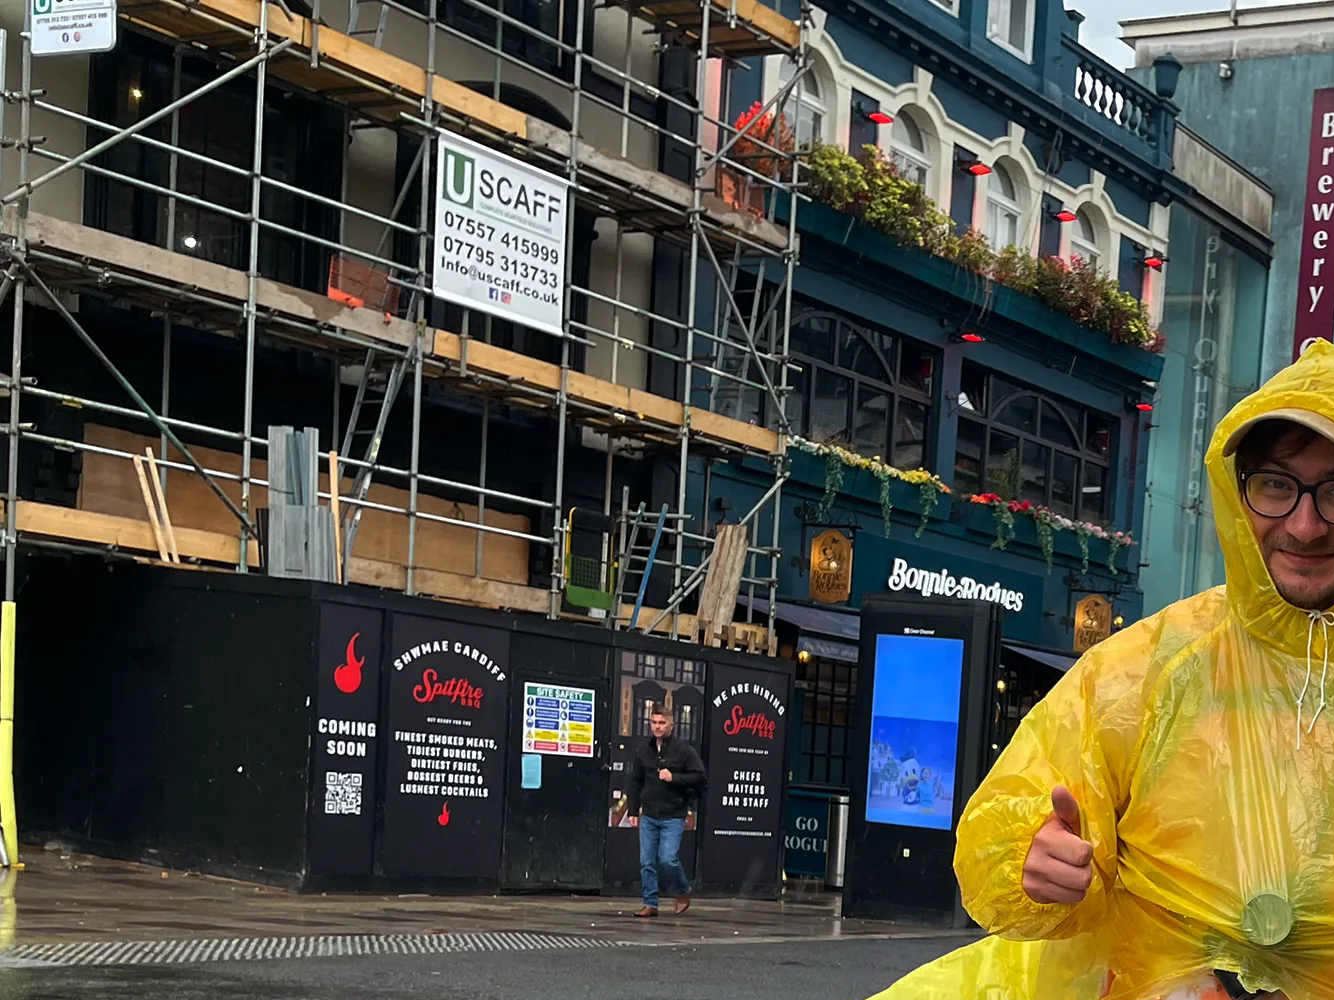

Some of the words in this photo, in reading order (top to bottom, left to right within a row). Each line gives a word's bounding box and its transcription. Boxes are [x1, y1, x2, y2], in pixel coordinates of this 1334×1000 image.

[444, 211, 496, 242] 07557
[501, 232, 559, 265] 415999
[444, 236, 494, 266] 07795
[500, 256, 558, 288] 313733
[888, 558, 959, 597] Bonnie
[393, 640, 449, 671] SHWMAE
[454, 642, 506, 682] CARDIFF
[412, 668, 484, 704] Spitfire
[536, 688, 553, 697] SITE
[555, 689, 584, 700] SAFETY
[713, 690, 728, 708] WE
[731, 683, 750, 696] ARE
[753, 684, 785, 716] HIRING
[318, 718, 376, 737] COMING
[724, 704, 776, 736] Spitfire
[326, 740, 366, 757] SOON
[395, 731, 426, 743] FINEST
[429, 734, 464, 746] SMOKED
[466, 737, 498, 750] MEATS,
[407, 745, 441, 757] TIDIEST
[443, 748, 486, 761] BURGERS,
[411, 758, 451, 770] DIRTIEST
[453, 761, 480, 774] FRIES,
[407, 771, 446, 782] BOSSEST
[448, 774, 475, 784] BEERS
[734, 770, 761, 782] CHEFS
[400, 783, 439, 795] LUSHEST
[441, 786, 489, 798] COCKTAILS
[728, 783, 765, 795] WAITERS
[722, 796, 739, 806] BAR
[743, 797, 769, 808] STAFF
[796, 816, 818, 832] GO
